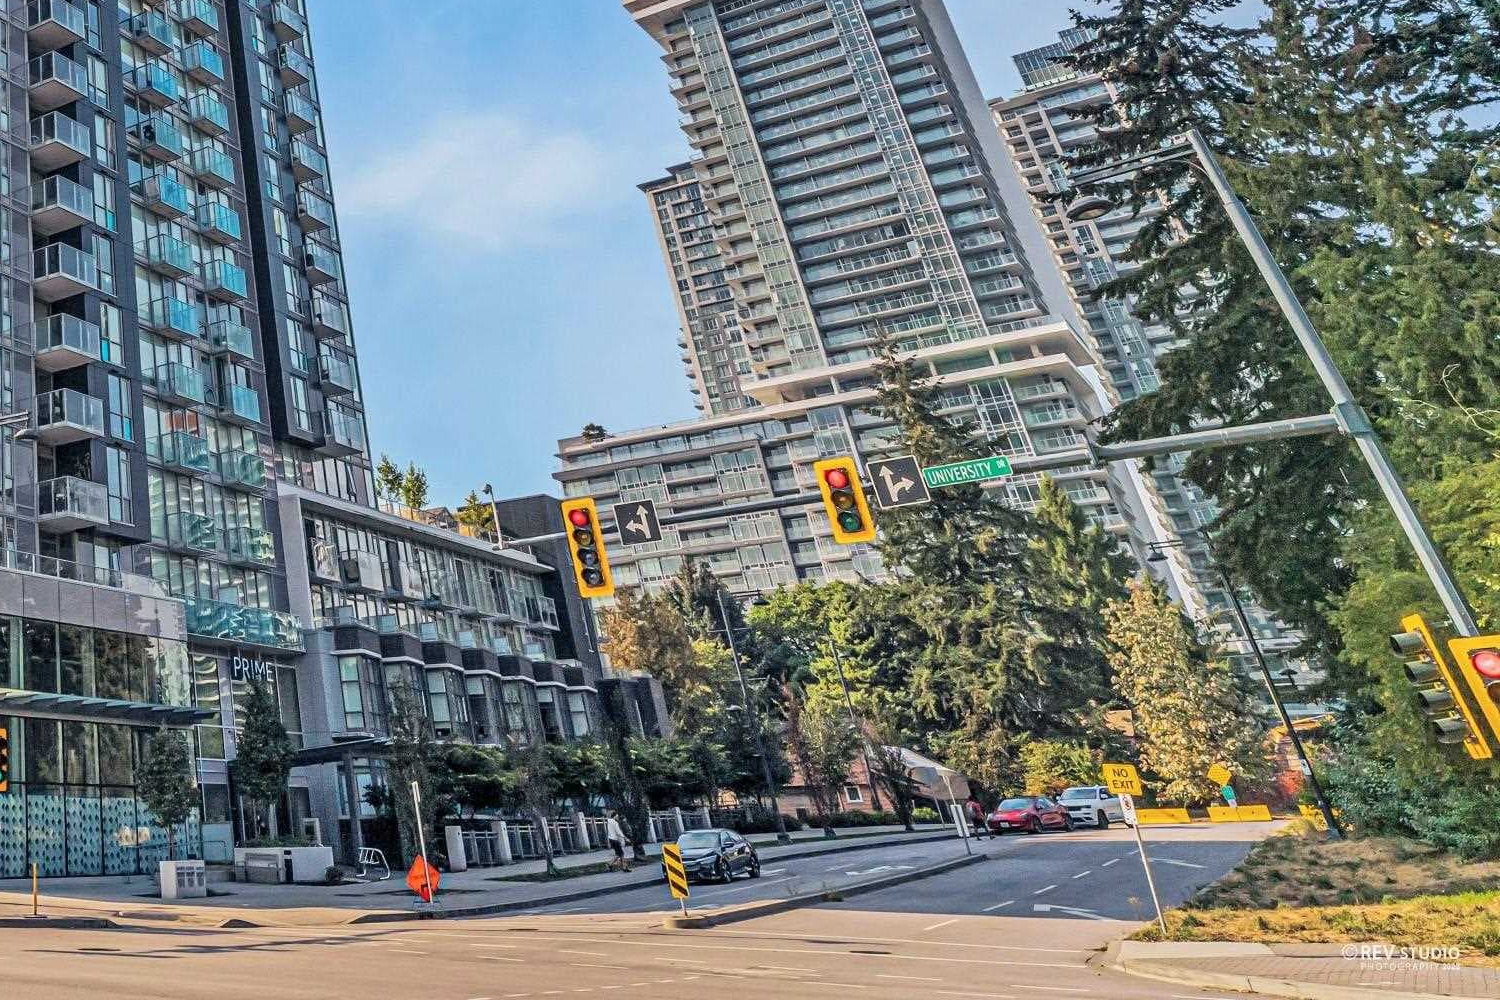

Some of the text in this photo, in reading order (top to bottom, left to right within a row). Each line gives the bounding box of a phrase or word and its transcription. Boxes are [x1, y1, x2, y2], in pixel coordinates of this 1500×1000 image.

[927, 458, 1007, 485] UNIVERSITY DR
[233, 656, 274, 682] PRIME
[1112, 768, 1129, 778] NO
[1112, 779, 1134, 790] EXIT
